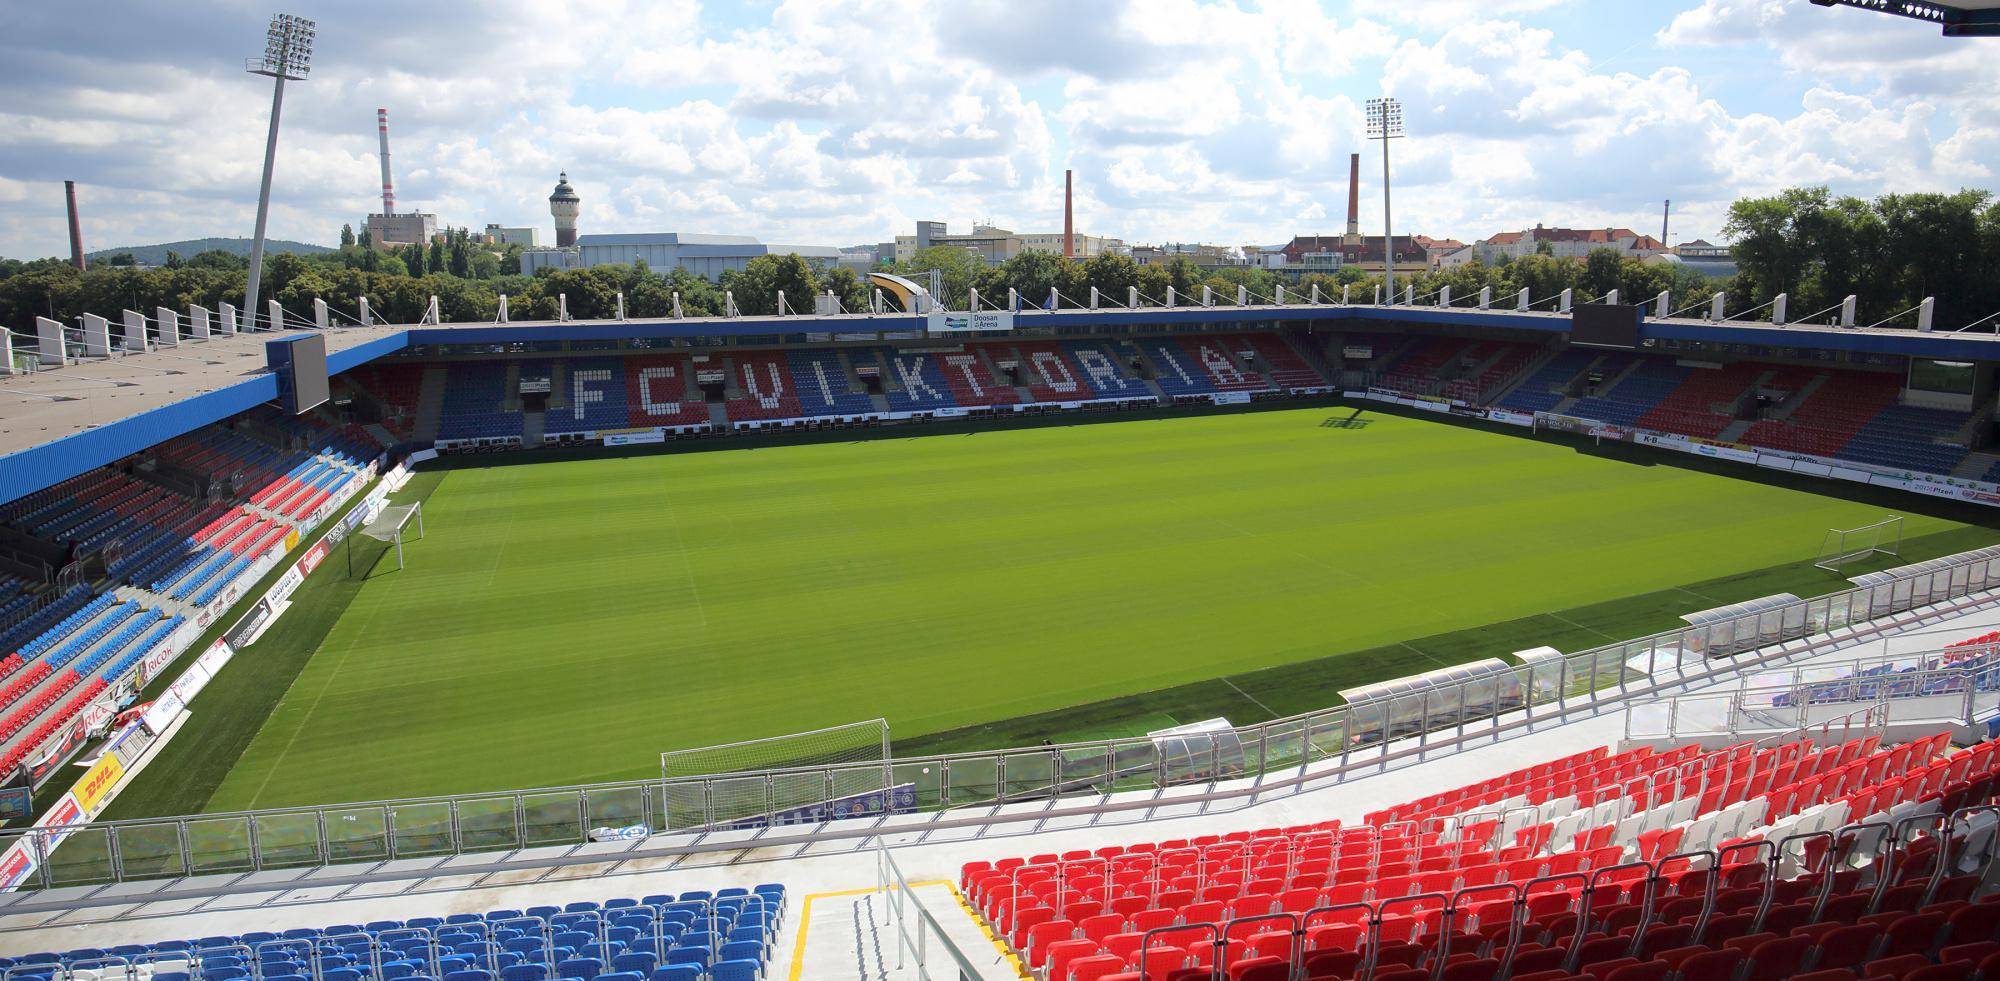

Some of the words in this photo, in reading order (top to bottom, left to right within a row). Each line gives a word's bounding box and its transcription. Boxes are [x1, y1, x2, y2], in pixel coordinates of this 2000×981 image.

[974, 314, 998, 322] Doosan
[574, 366, 682, 420] FC
[148, 646, 173, 672] RICOH
[85, 766, 113, 800] DHL
